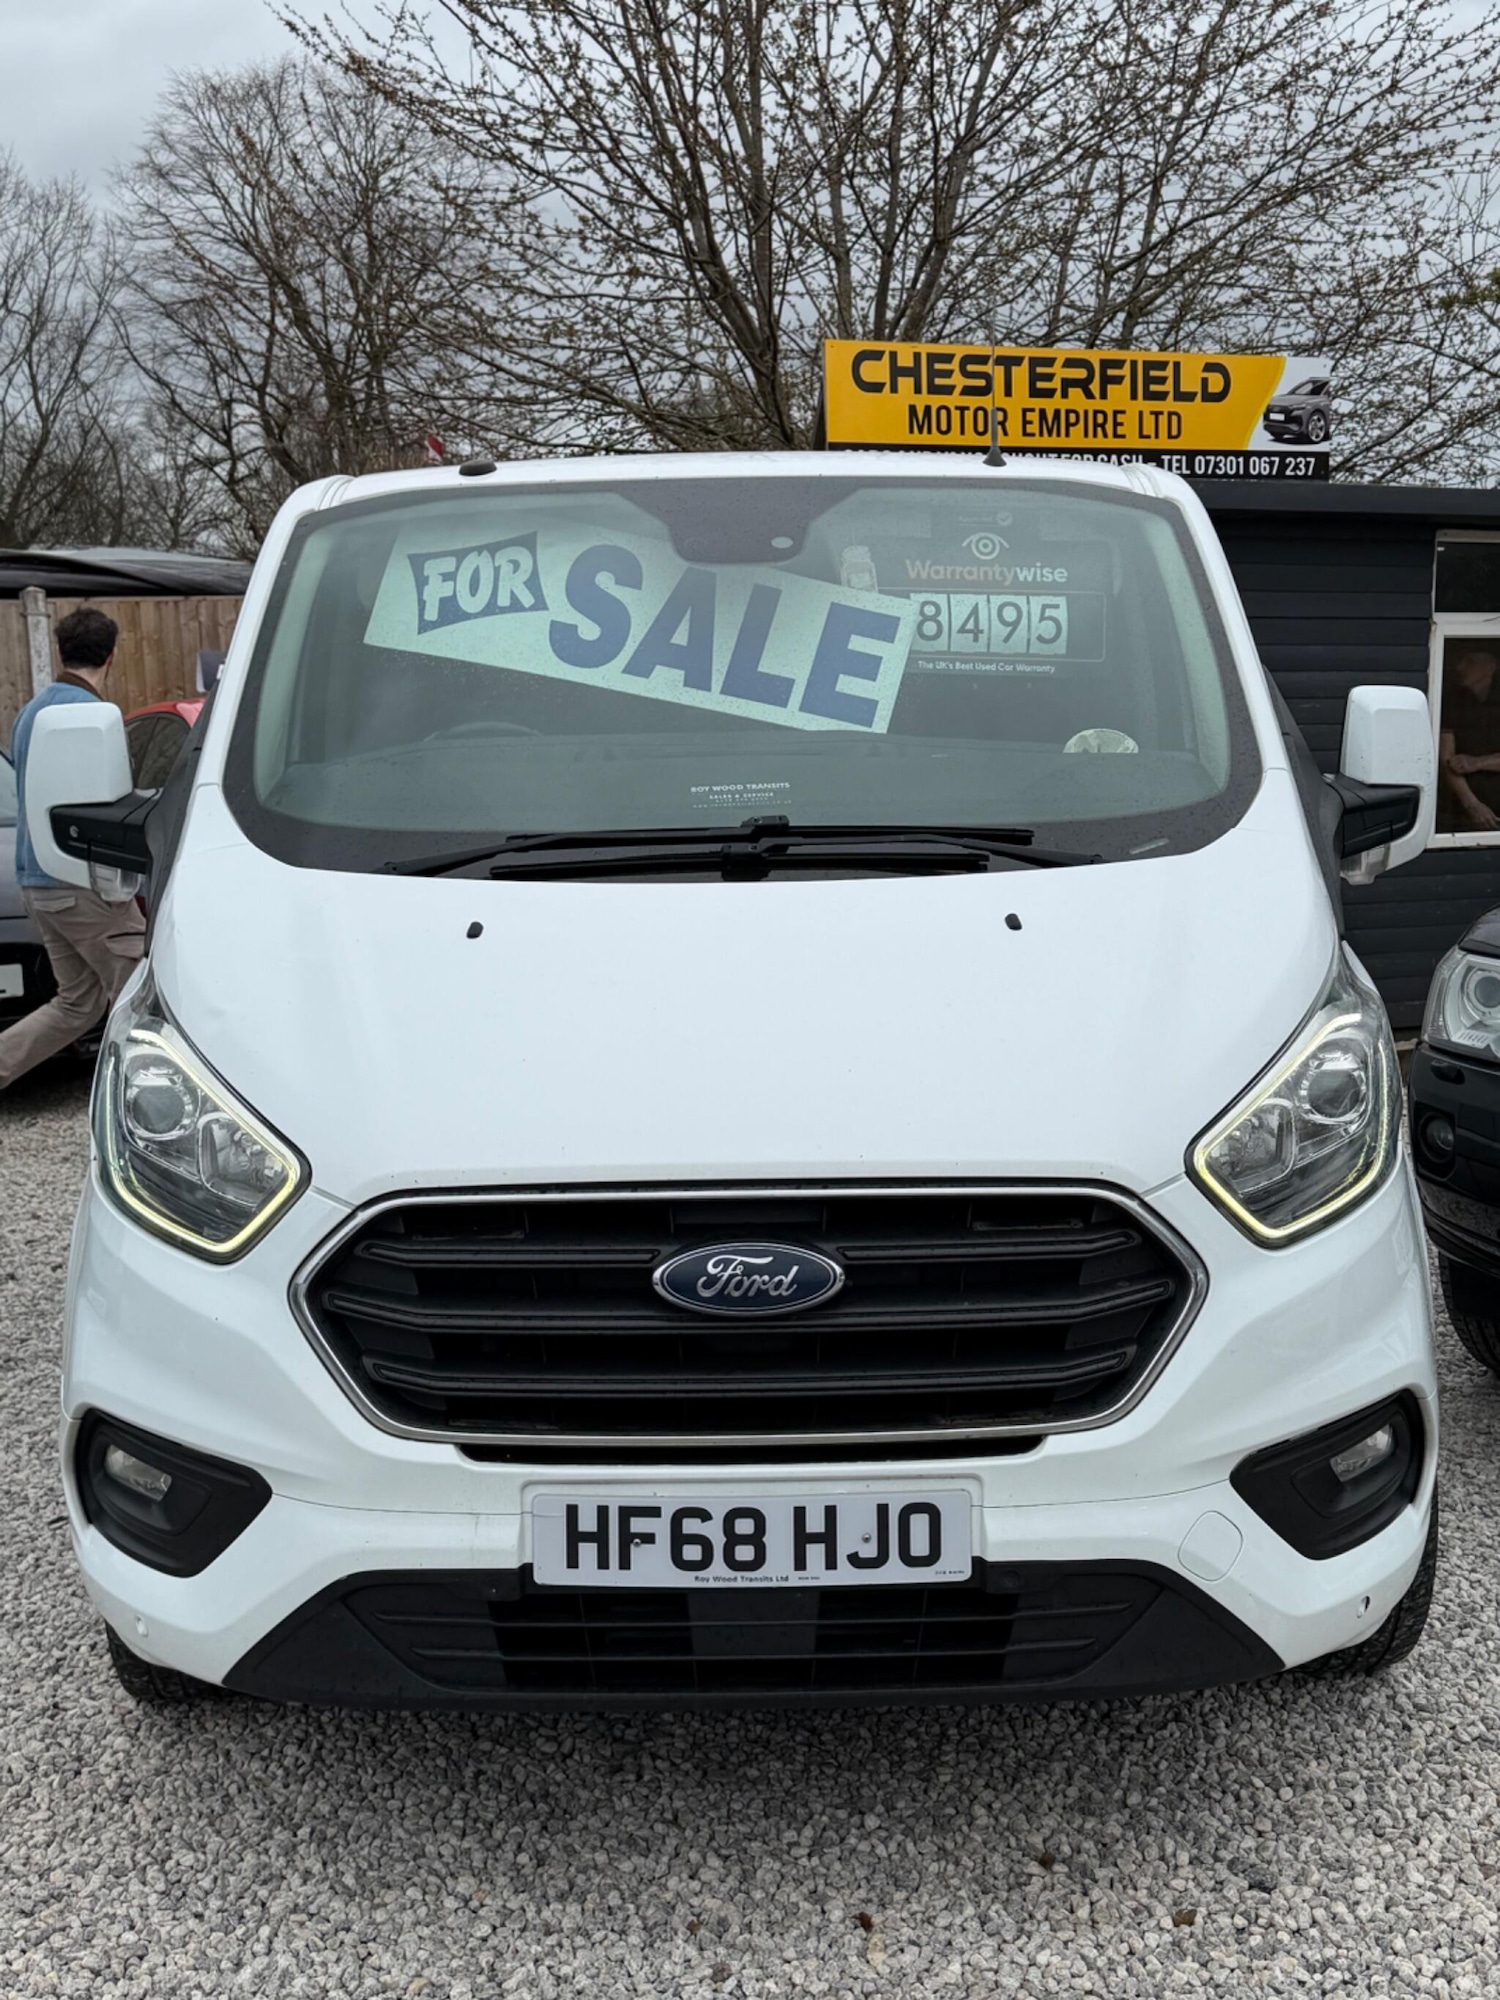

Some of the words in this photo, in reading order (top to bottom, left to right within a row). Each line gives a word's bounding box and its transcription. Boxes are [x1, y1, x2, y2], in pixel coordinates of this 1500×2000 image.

[851, 349, 1231, 403] CHESTERFIELD
[908, 404, 1009, 437] MOTOR
[1022, 407, 1126, 440] EMPIRE
[1138, 409, 1182, 440] LTD
[1161, 455, 1190, 474] TEL
[1195, 455, 1244, 474] 07301
[1250, 456, 1279, 475] 067
[1285, 457, 1315, 476] 237
[906, 560, 1068, 586] Warrantywise
[423, 545, 535, 621] FOR
[548, 544, 901, 729] SALE
[916, 600, 1063, 644] 8495
[918, 660, 934, 670] The
[935, 661, 953, 670] UK's
[955, 661, 974, 671] Best
[975, 662, 996, 671] Used
[998, 663, 1014, 671] Car
[1016, 663, 1056, 674] Warranty
[712, 784, 744, 792] WOOD
[745, 782, 790, 790] TRANSITS
[696, 1255, 799, 1297] Ford
[566, 1503, 766, 1572] HF68
[793, 1502, 941, 1571] HJO
[694, 1575, 710, 1583] Roy
